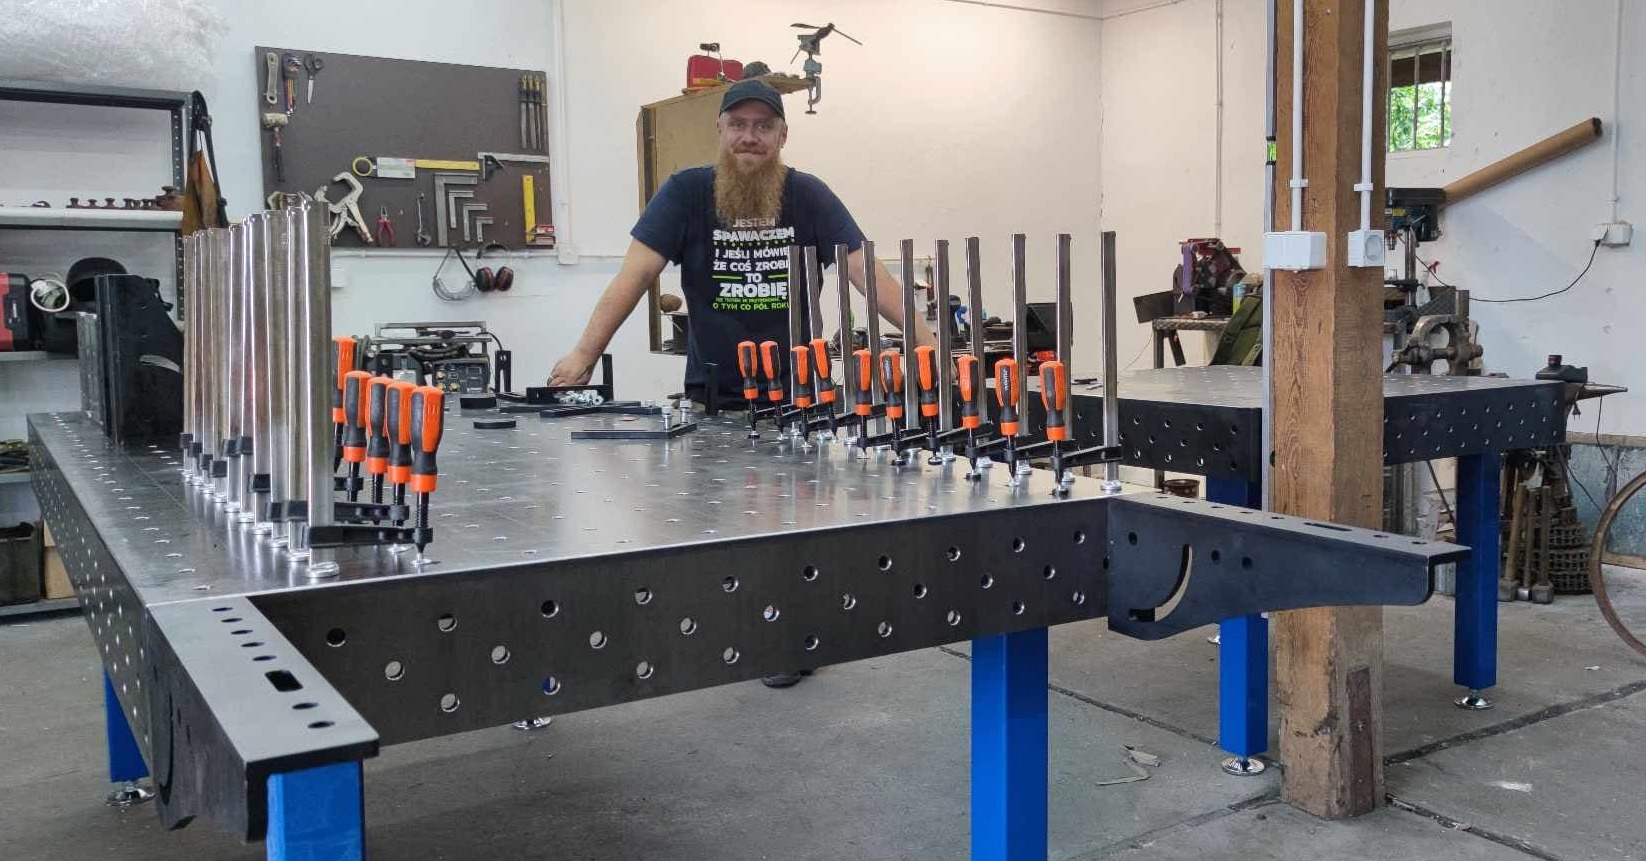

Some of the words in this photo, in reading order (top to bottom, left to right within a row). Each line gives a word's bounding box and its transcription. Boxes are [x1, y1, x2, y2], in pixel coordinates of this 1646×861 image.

[713, 226, 795, 242] SPAWACZEM
[715, 248, 720, 258] I
[713, 259, 727, 271] ŻE
[729, 260, 752, 272] COŚ
[755, 260, 789, 272] ZROBI
[745, 272, 763, 283] TO
[720, 281, 788, 300] ZROBIĘ
[712, 302, 719, 310] O
[721, 302, 738, 311] TYM
[740, 303, 752, 311] CO
